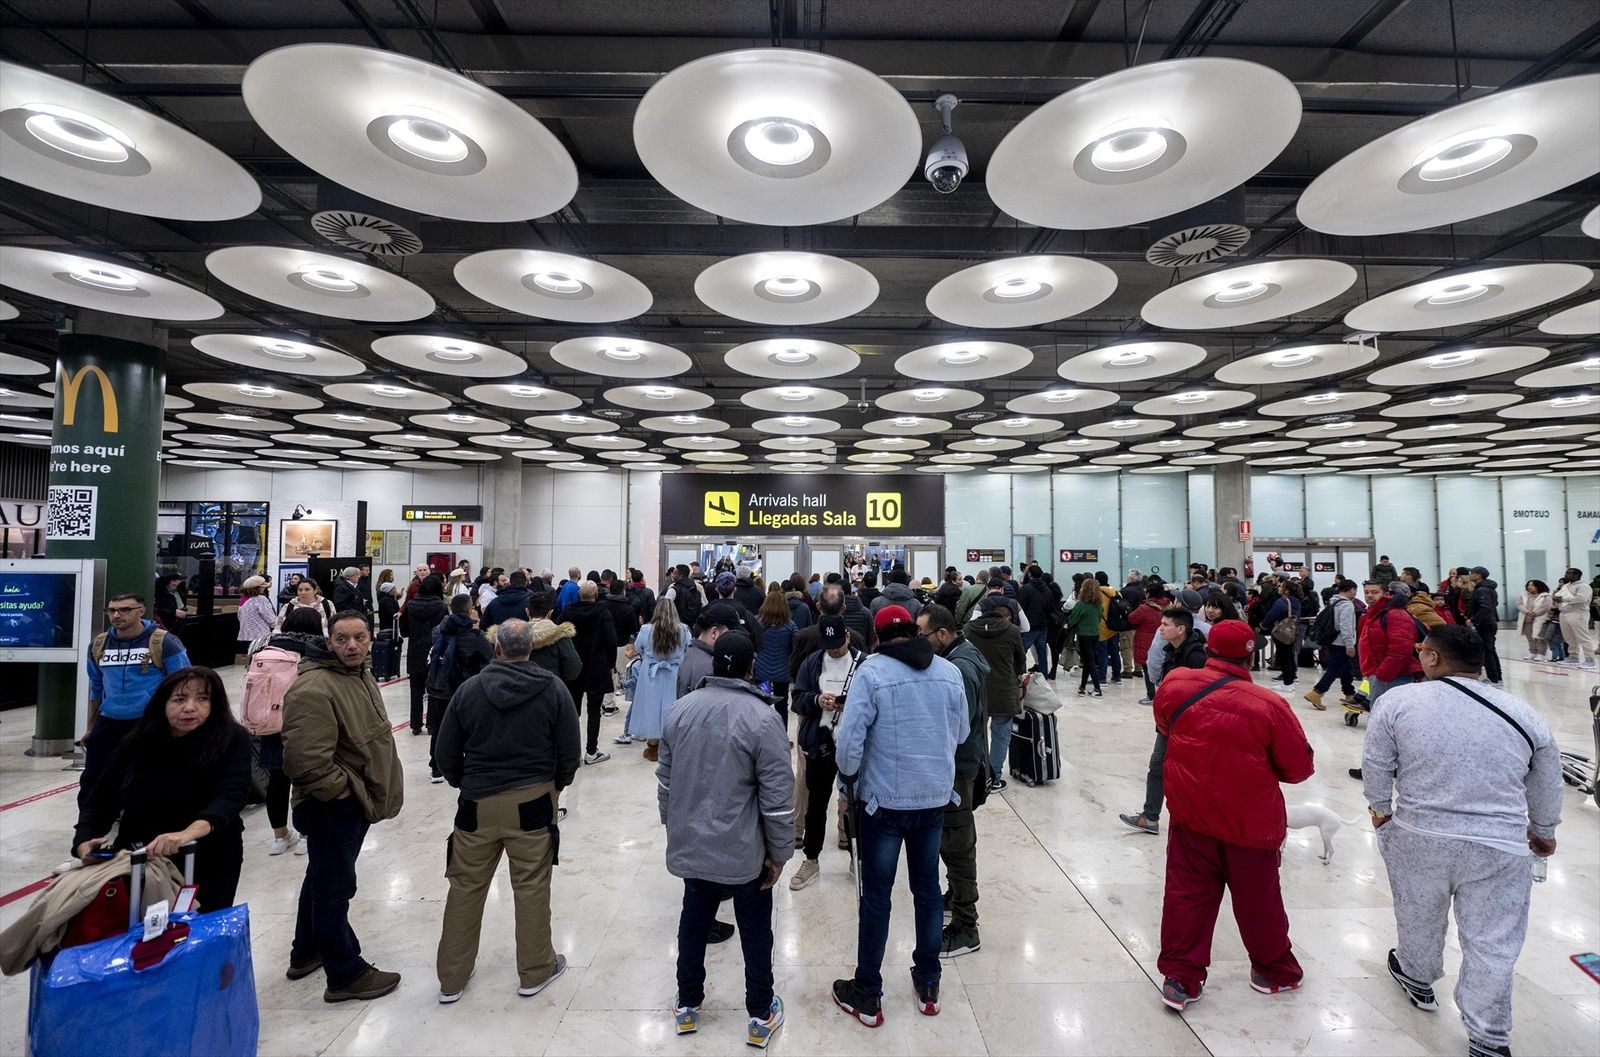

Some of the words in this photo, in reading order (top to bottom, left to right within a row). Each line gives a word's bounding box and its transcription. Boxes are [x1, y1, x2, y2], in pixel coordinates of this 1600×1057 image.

[84, 445, 125, 458] aquí
[70, 461, 111, 473] here
[749, 493, 798, 507] Arrivals
[803, 493, 827, 507] hall
[869, 499, 899, 521] 10
[749, 511, 818, 529] Llegadas
[823, 511, 856, 526] Sala
[19, 601, 44, 611] ayuda?
[103, 650, 146, 662] adidas
